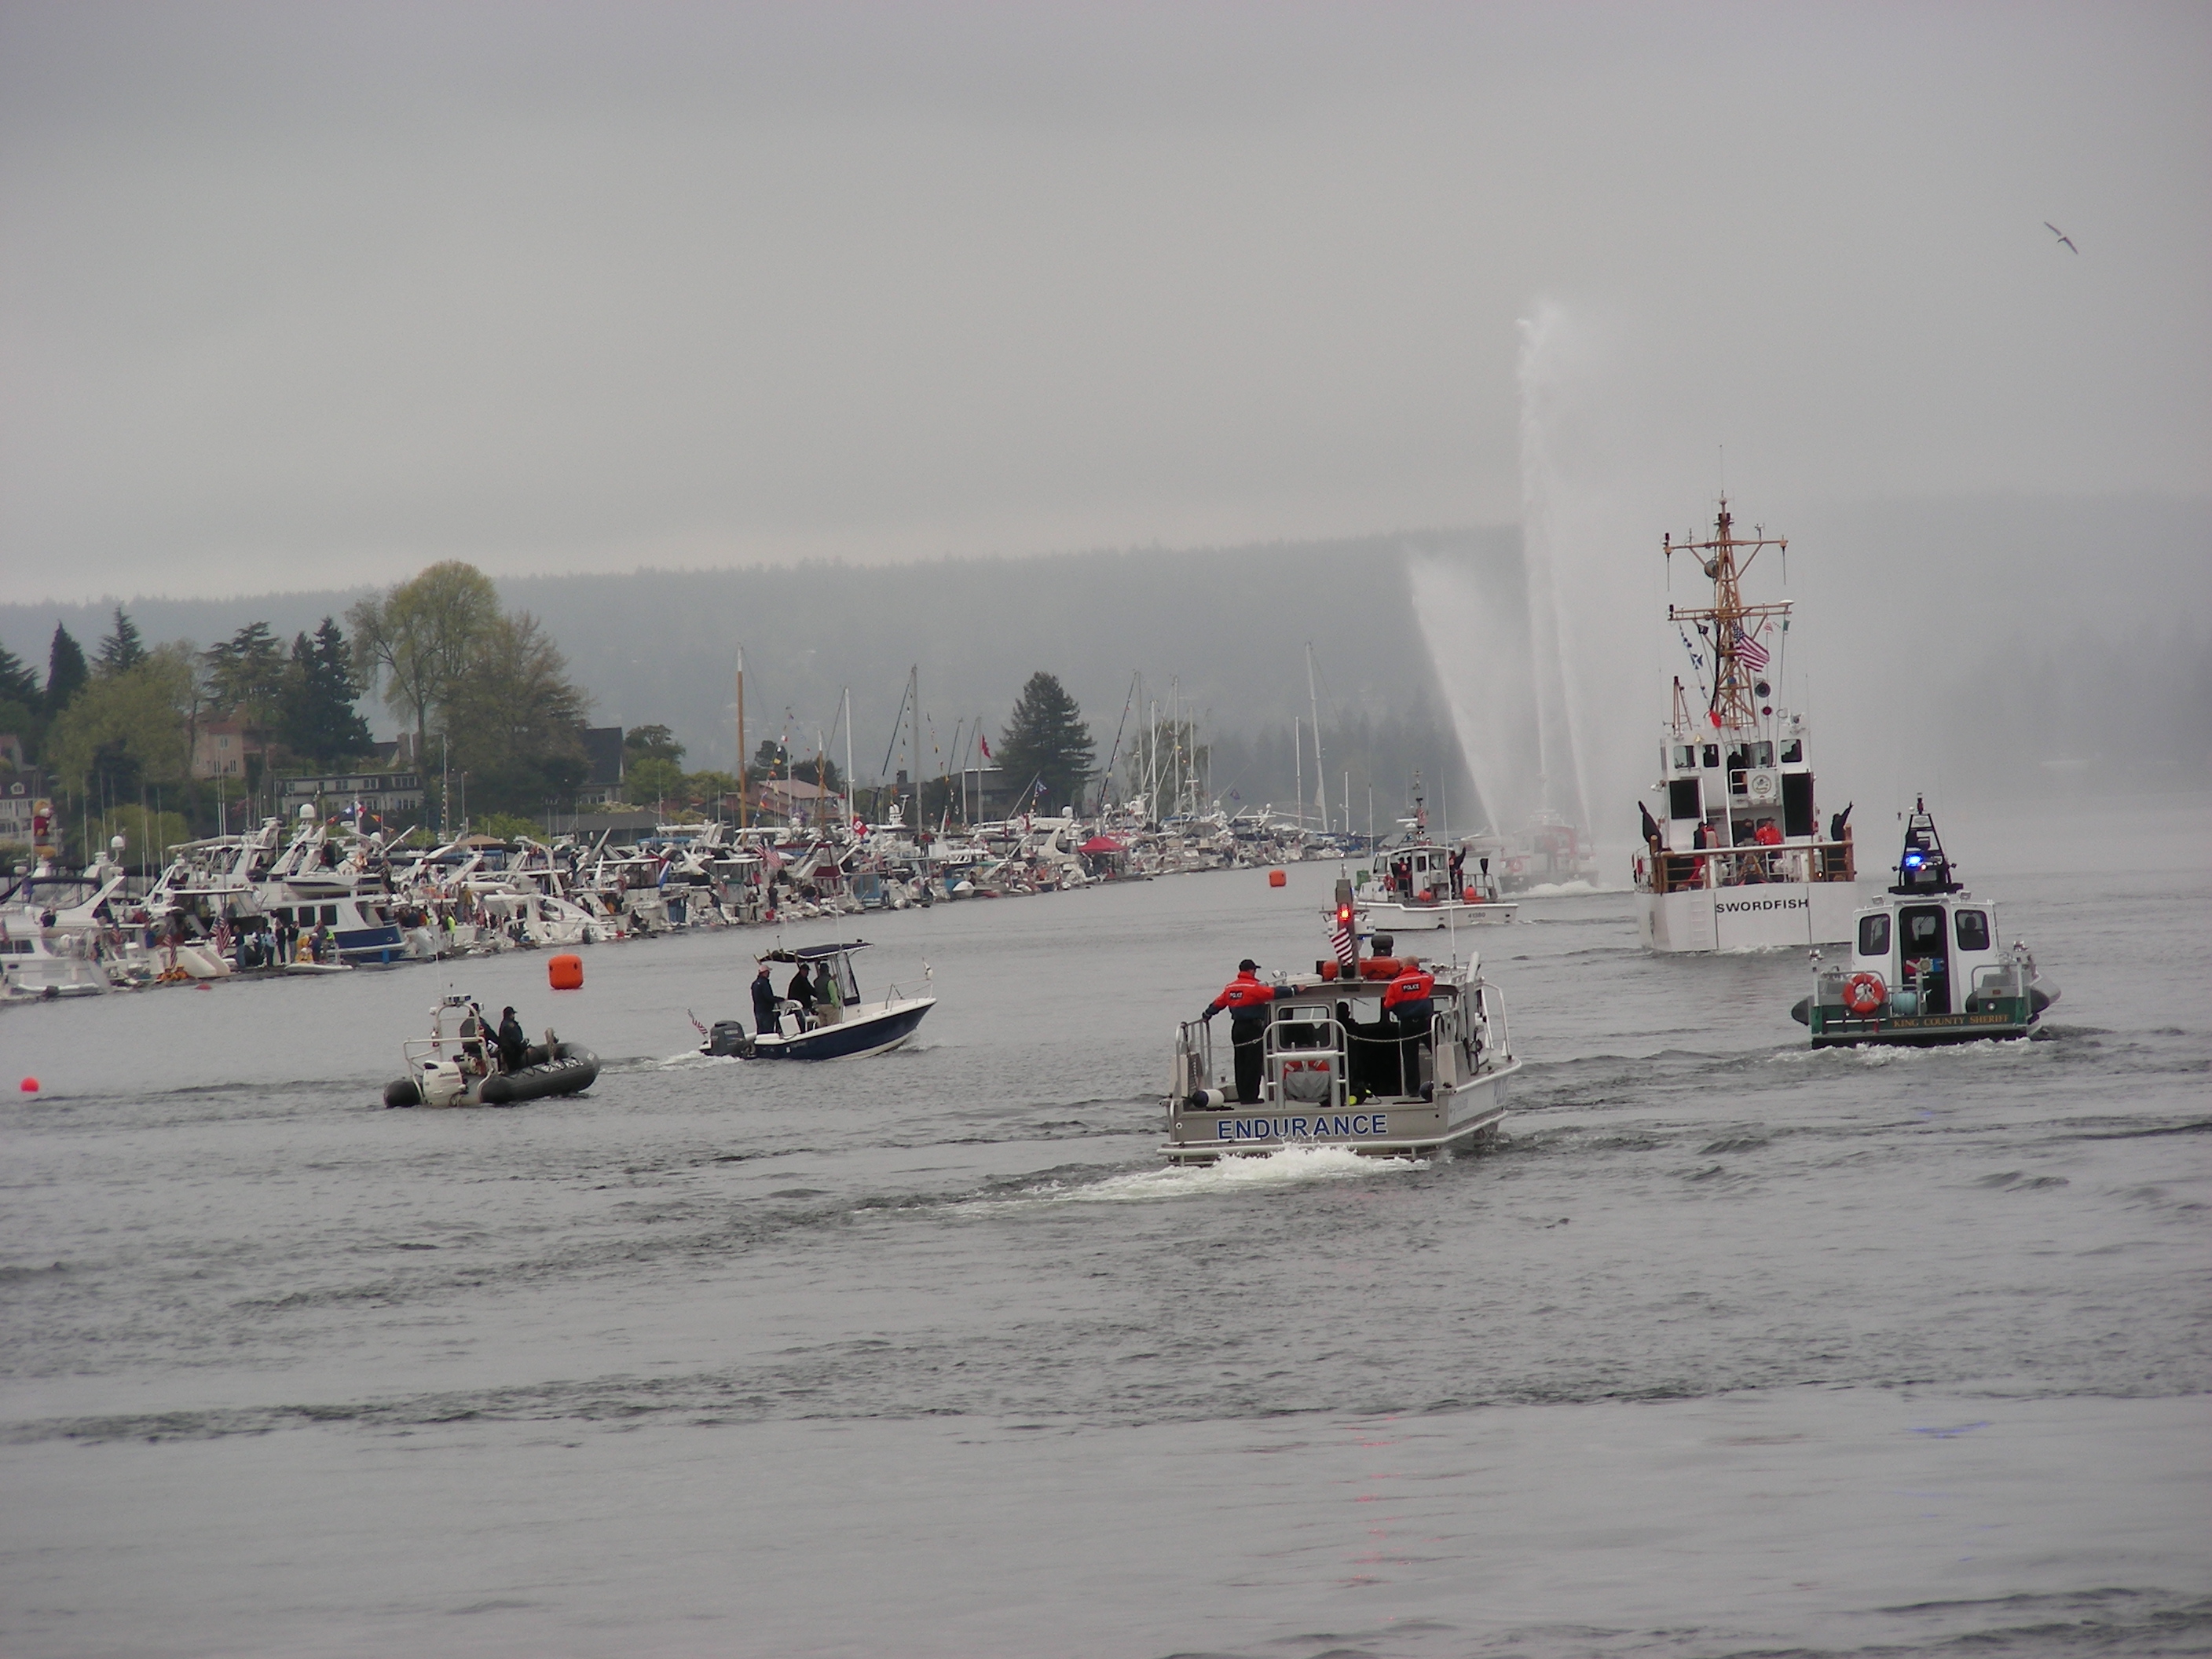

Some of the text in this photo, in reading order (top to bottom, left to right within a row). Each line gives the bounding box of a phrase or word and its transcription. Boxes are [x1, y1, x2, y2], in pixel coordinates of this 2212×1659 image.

[1716, 899, 1808, 913] SWORDFISH
[1893, 1014, 2009, 1027] KING COUNTY SHERIFF
[1218, 1114, 1388, 1140] ENDURANCE
